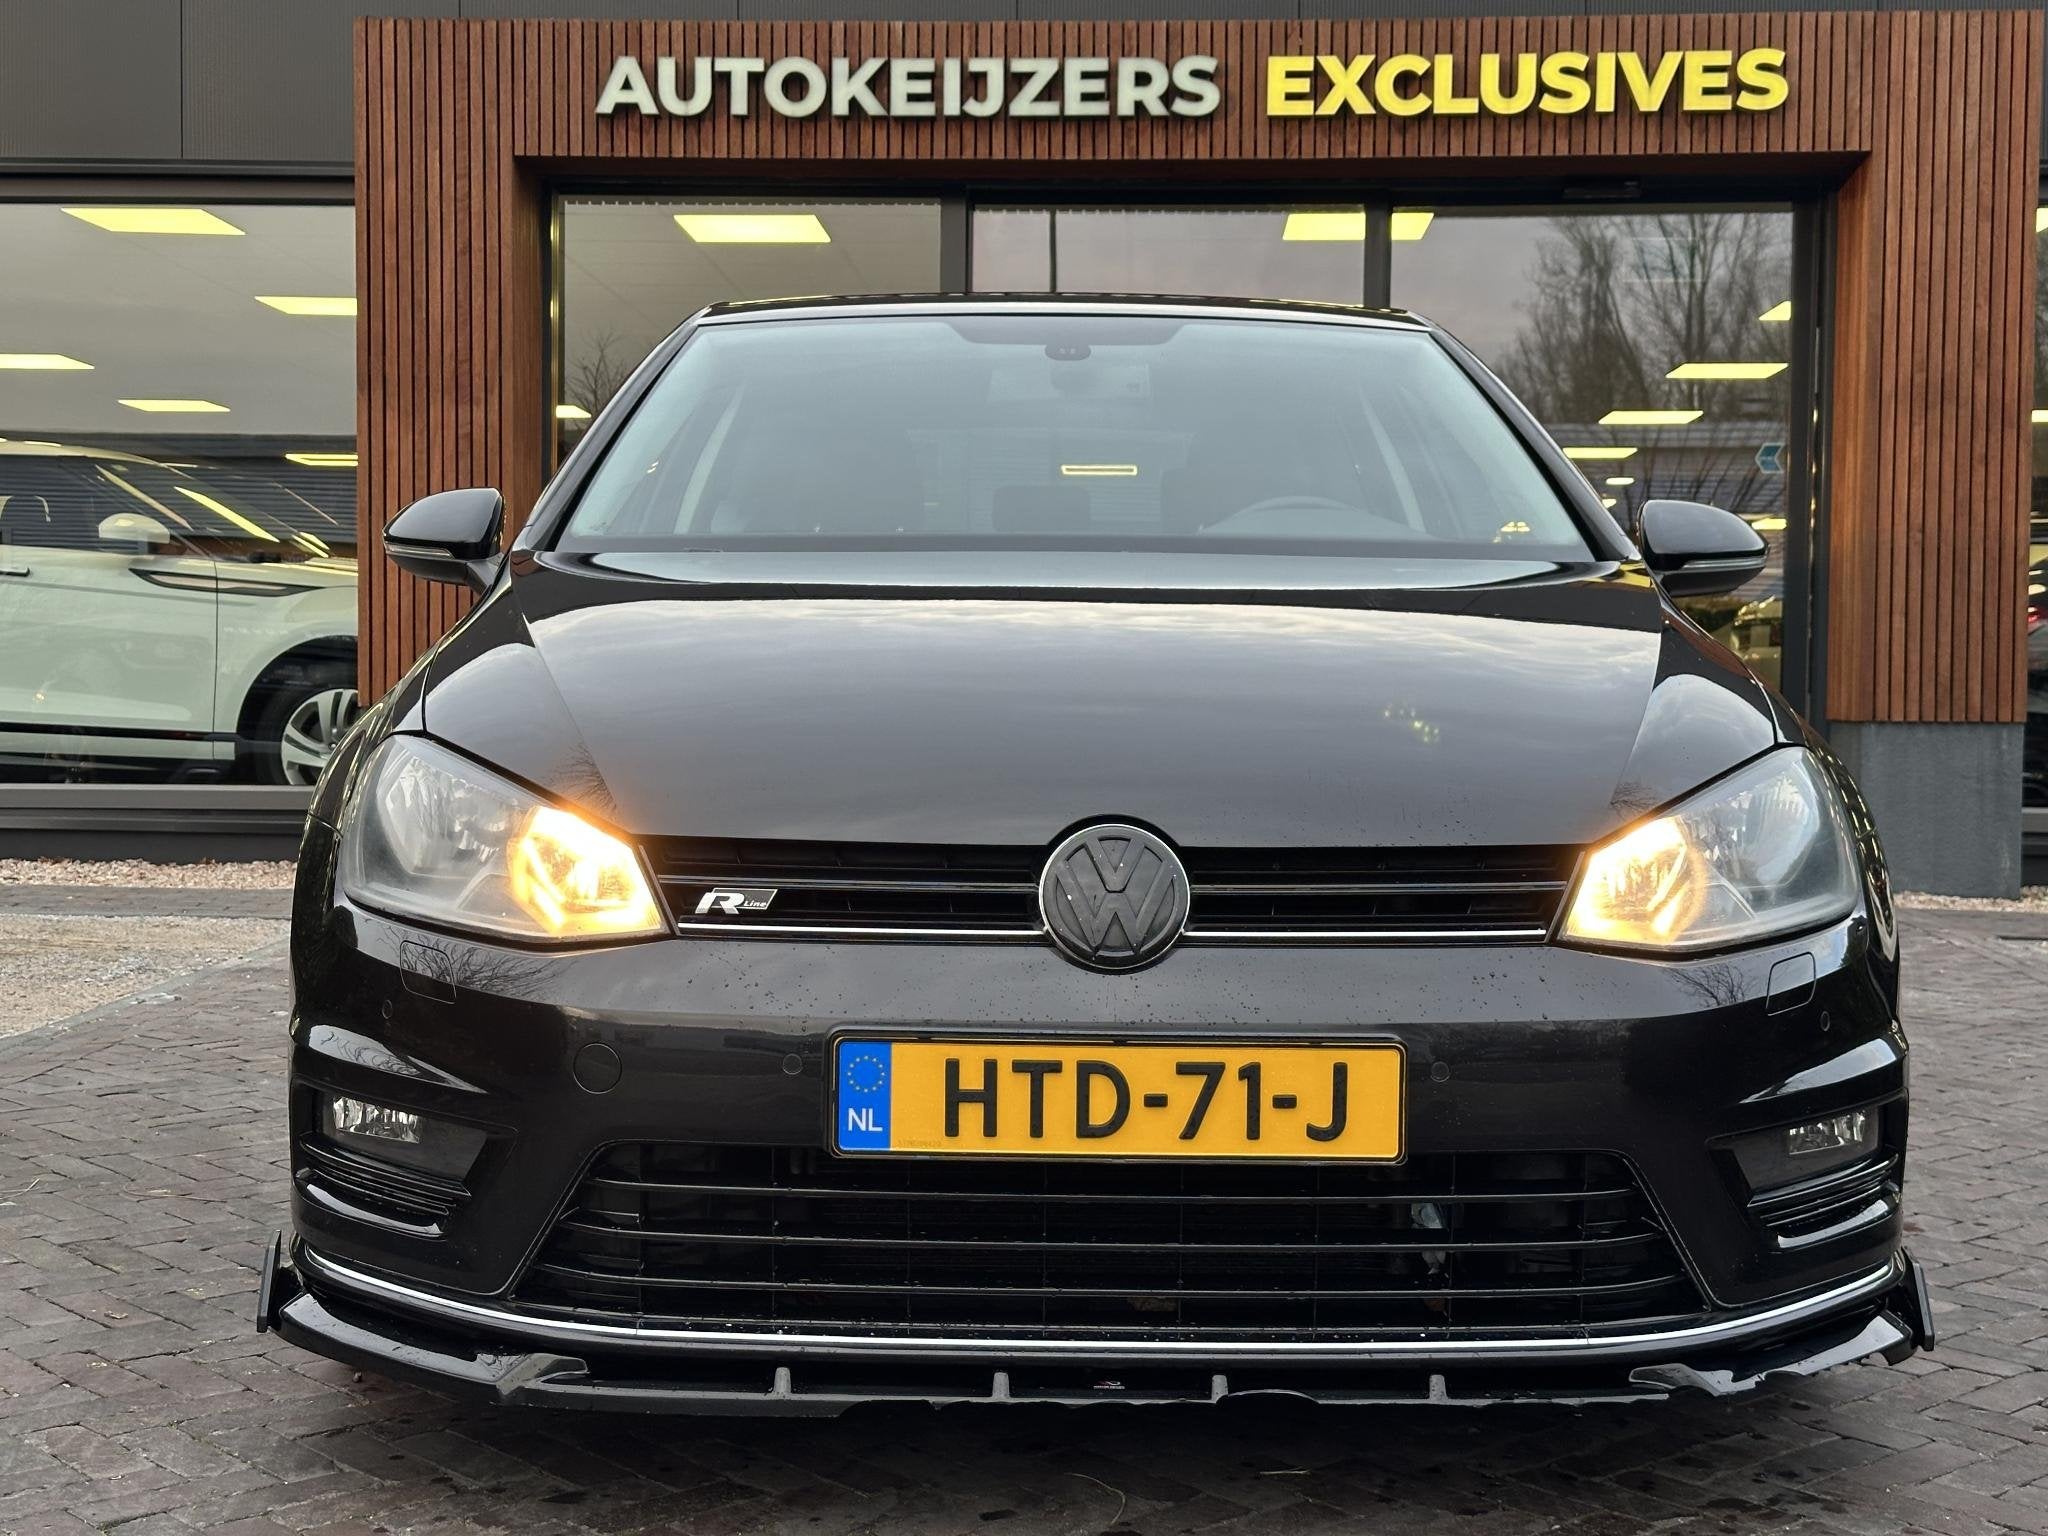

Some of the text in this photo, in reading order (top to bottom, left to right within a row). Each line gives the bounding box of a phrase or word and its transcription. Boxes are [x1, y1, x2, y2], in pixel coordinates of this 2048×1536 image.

[596, 49, 1789, 119] AUTOKEIJZERS EXCLUSIVES
[695, 892, 744, 914] R
[848, 1108, 883, 1132] NL
[944, 1058, 1348, 1141] HTD-71-J
